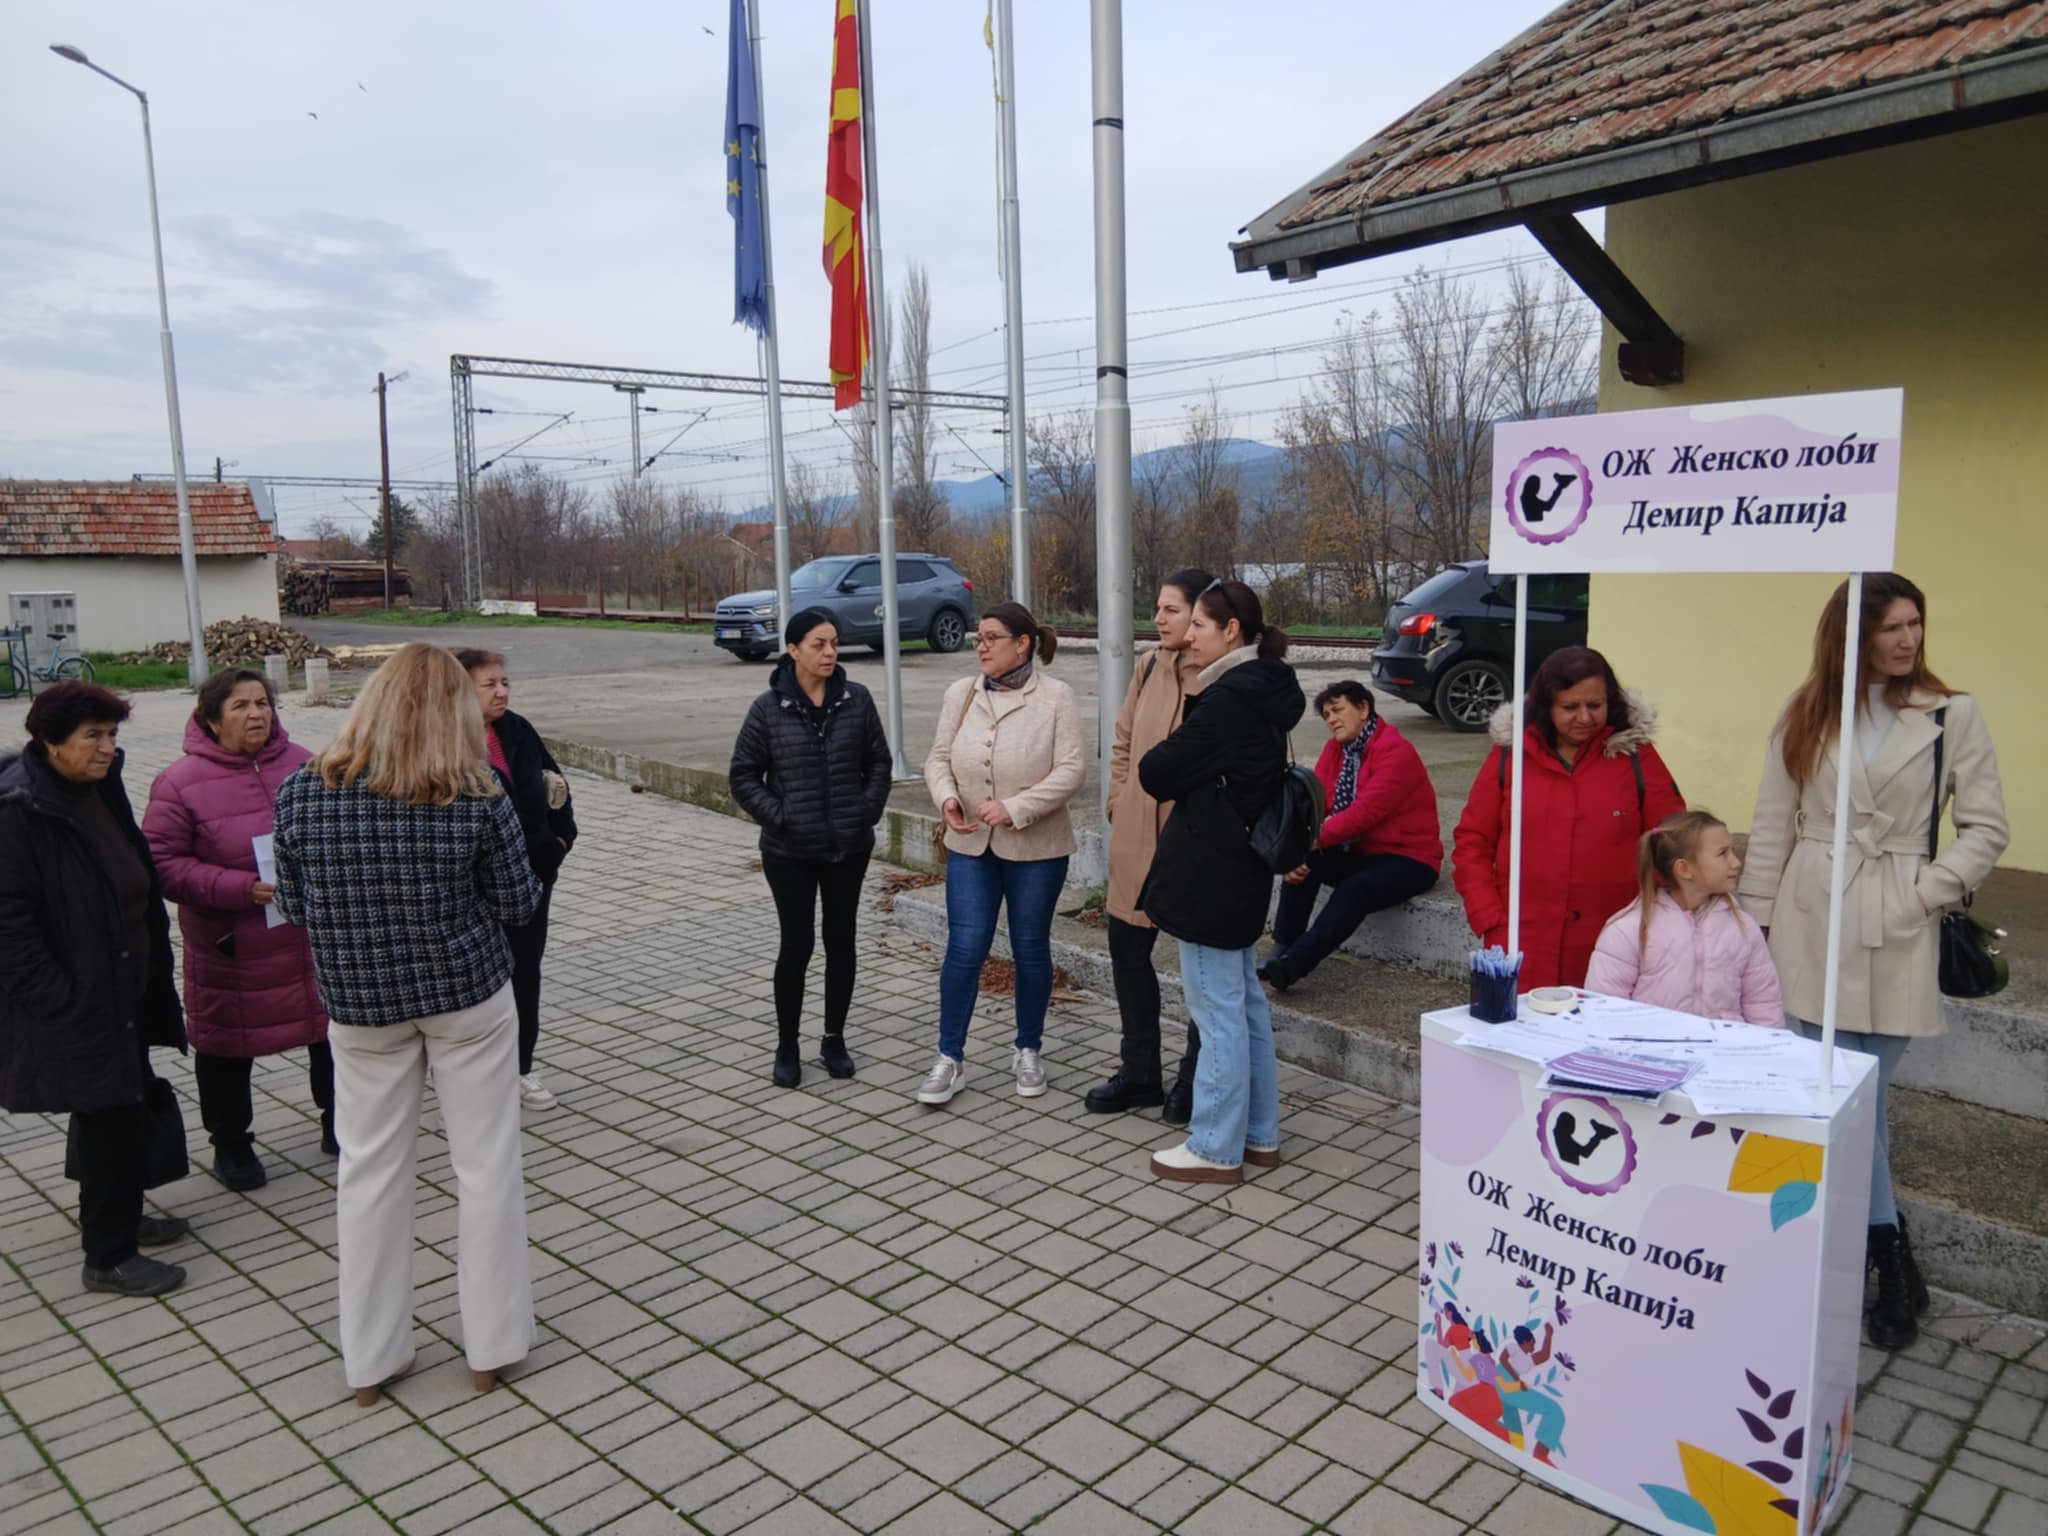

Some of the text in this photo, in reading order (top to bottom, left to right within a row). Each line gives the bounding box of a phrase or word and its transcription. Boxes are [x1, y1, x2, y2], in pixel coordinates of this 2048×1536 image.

[1601, 433, 1880, 478] ОЖ Женско лоби
[1622, 493, 1848, 535] Демир Капија
[1468, 1169, 1728, 1284] ОЖ Женско лоби
[1485, 1227, 1696, 1330] Демир Капија
